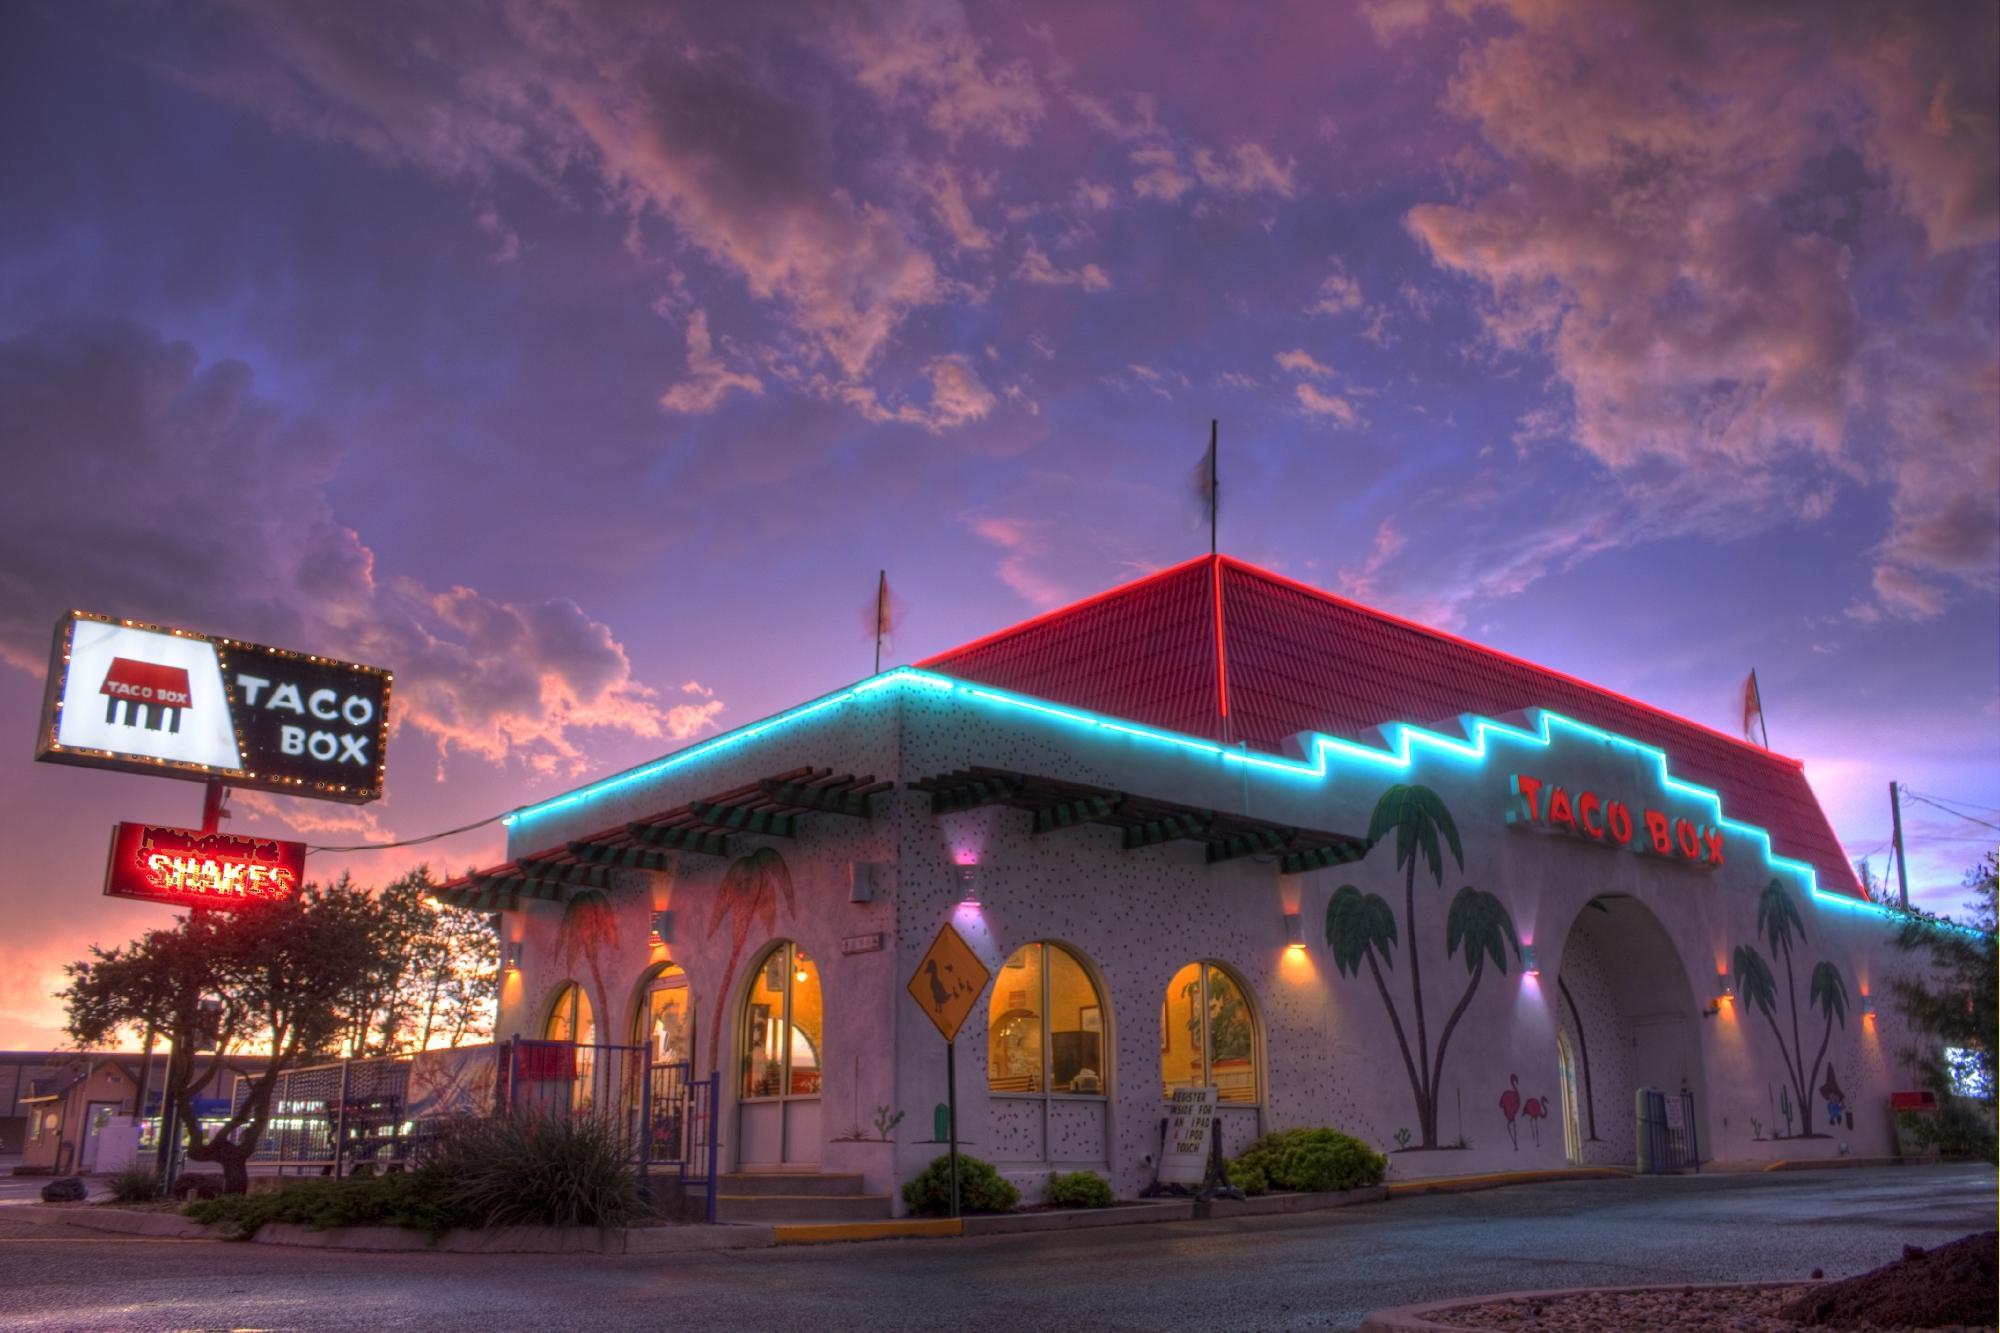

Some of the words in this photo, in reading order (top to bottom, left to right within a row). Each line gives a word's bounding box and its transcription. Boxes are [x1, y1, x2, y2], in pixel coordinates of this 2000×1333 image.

[107, 681, 152, 698] TACO
[157, 688, 188, 704] BOX
[236, 673, 374, 726] TACO
[280, 724, 370, 767] BOX
[1512, 775, 1633, 845] TACO
[1643, 806, 1725, 866] BOX
[145, 852, 296, 900] SHAKES
[1169, 1104, 1193, 1115] INSIDE
[1198, 1104, 1212, 1115] FOR
[1172, 1091, 1207, 1103] REGISTER
[1176, 1142, 1200, 1153] TOUCH
